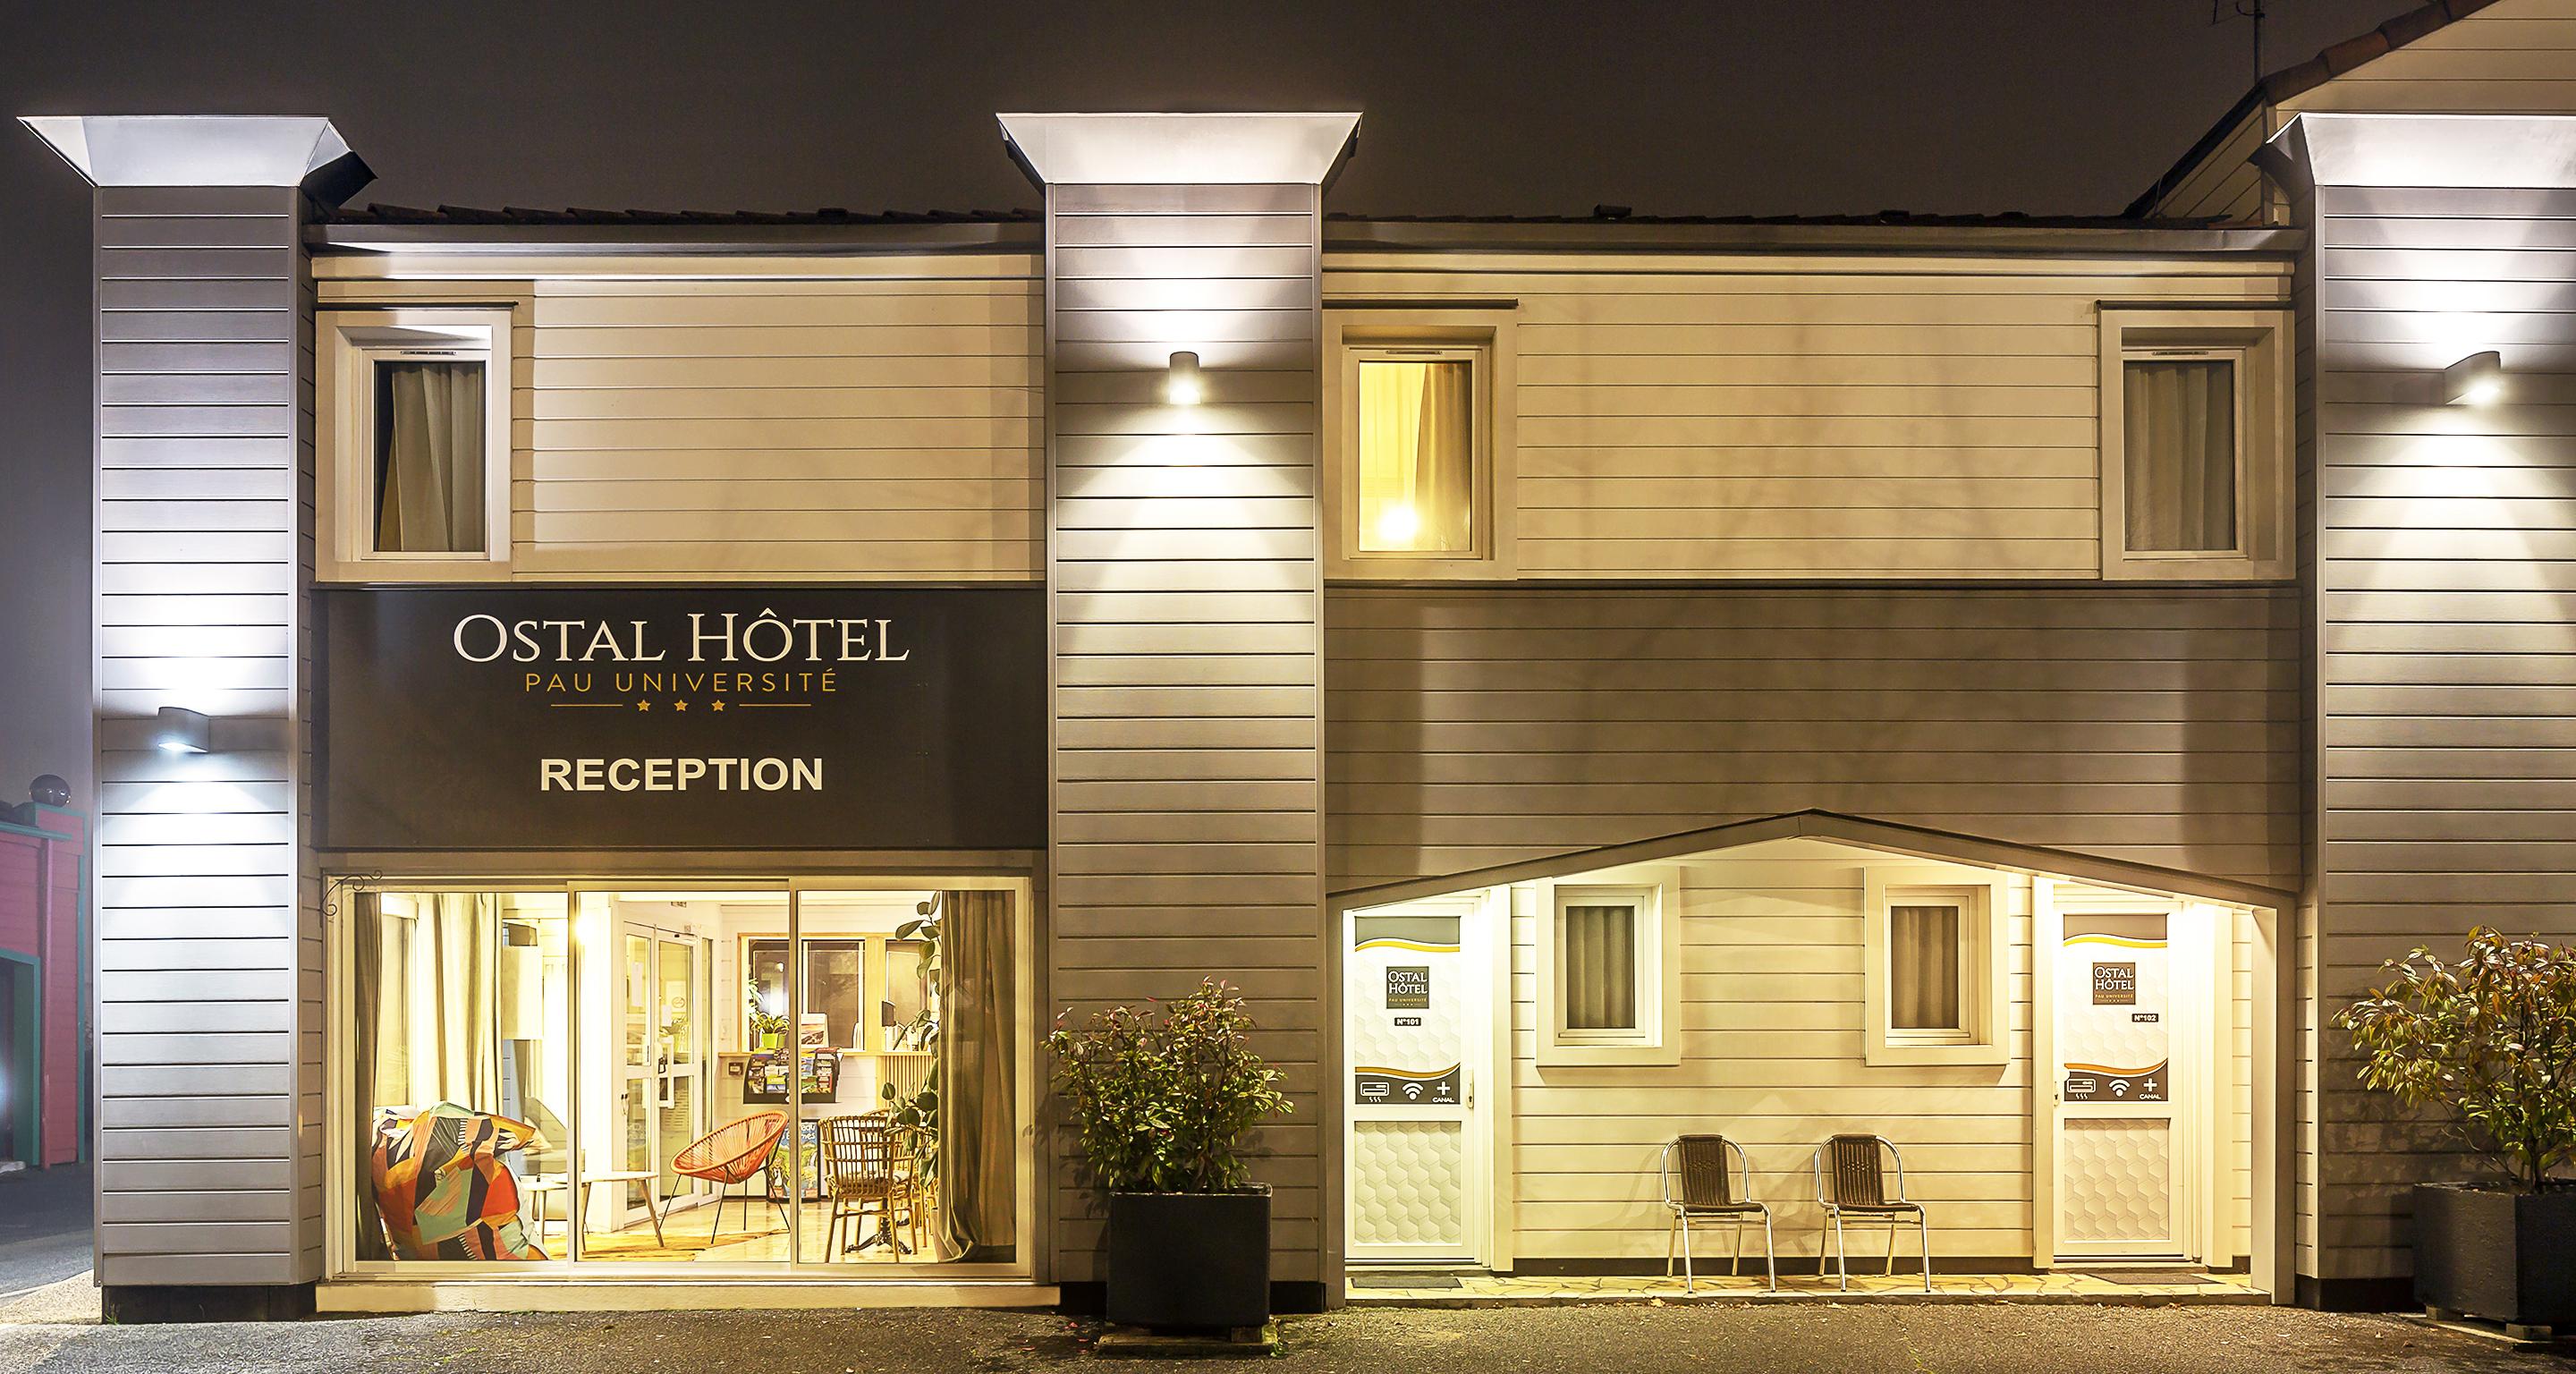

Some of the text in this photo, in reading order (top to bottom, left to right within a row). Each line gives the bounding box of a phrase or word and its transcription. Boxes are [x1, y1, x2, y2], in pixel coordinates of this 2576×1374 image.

[453, 607, 910, 663] OSTAL HÔTEL
[525, 667, 836, 692] PAU UNIVERSITÉ
[540, 758, 824, 792] RECEPTION
[1387, 971, 1428, 983] OSTAL
[2094, 966, 2133, 979] OSTAL
[1388, 981, 1428, 994] HÔTEL
[2095, 978, 2134, 990] HÔTEL
